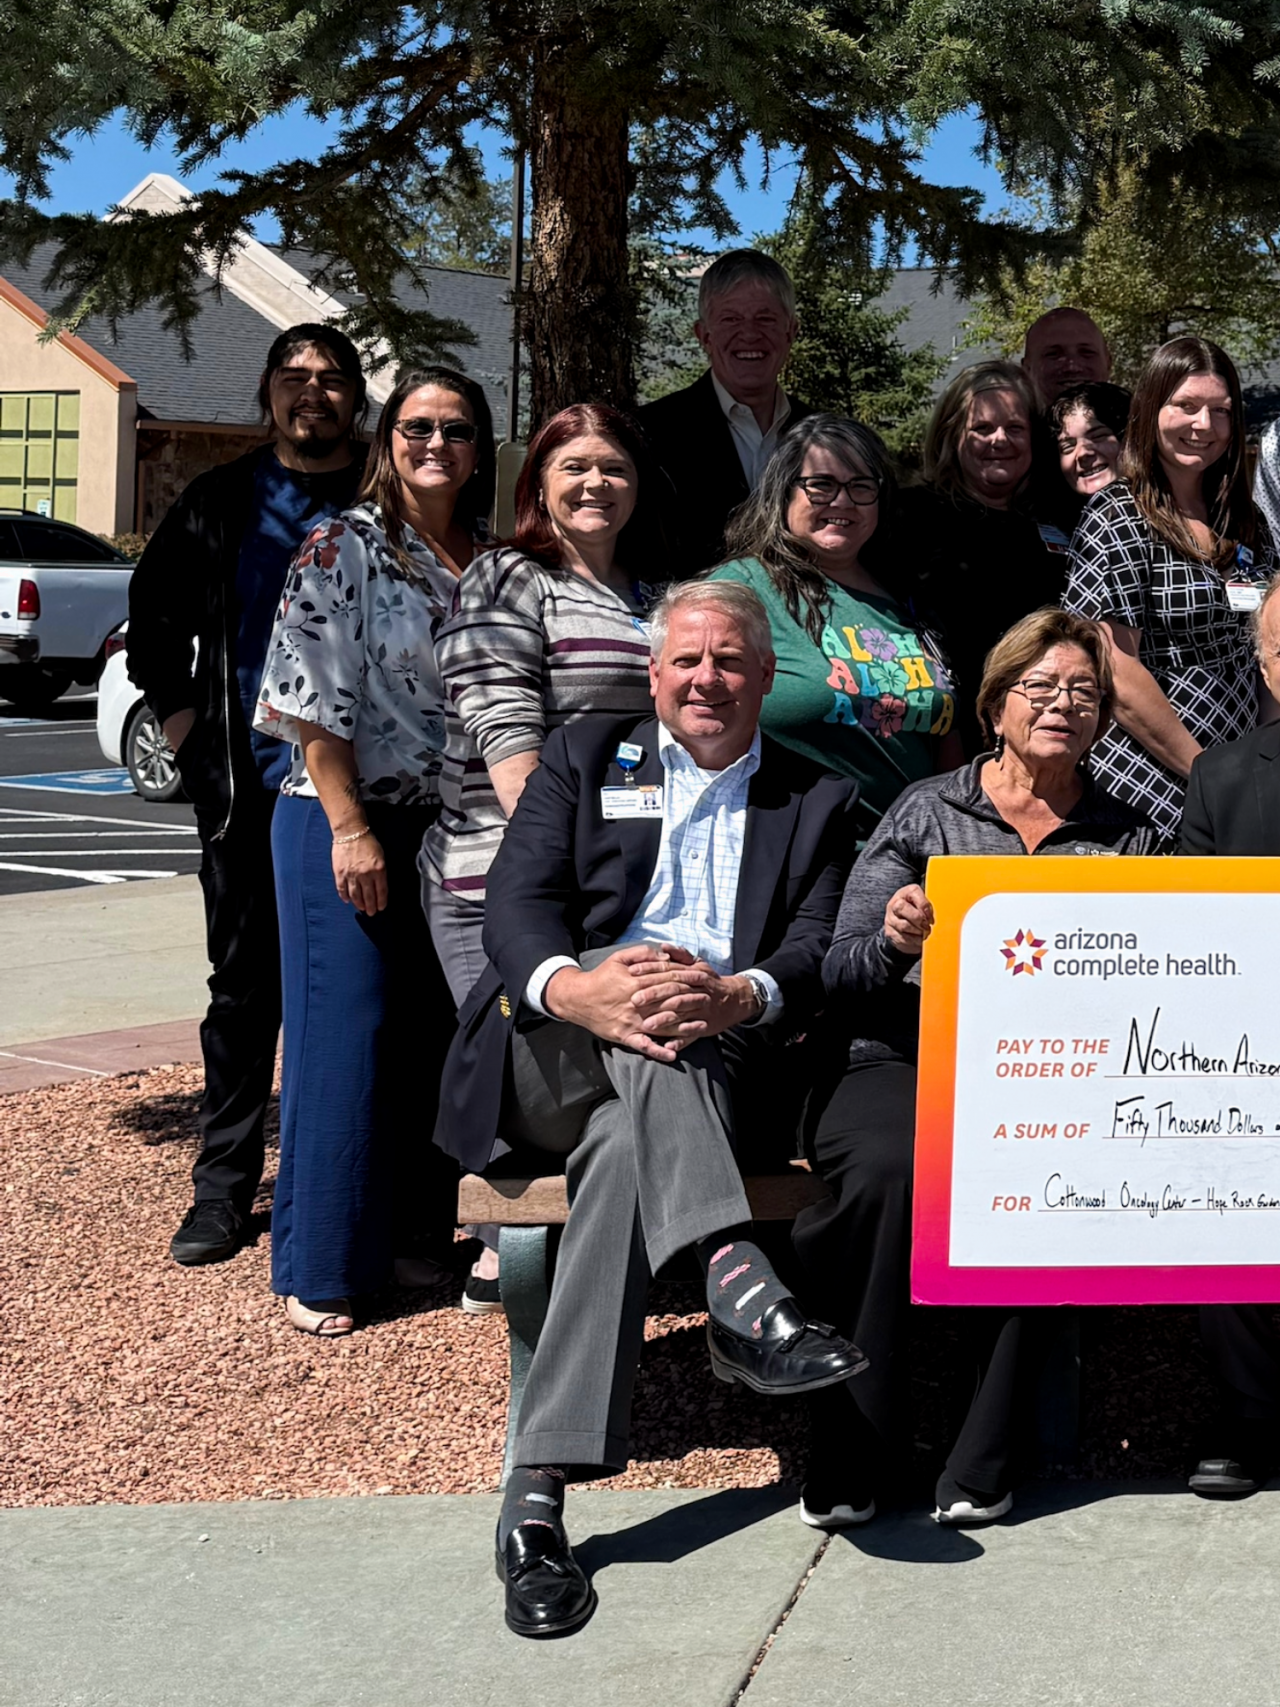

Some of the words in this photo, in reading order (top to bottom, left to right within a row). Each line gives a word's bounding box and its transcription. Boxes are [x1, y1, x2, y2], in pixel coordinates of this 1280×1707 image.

[1054, 928, 1138, 951] arizona
[1053, 953, 1160, 980] complete
[996, 1039, 1032, 1055] PAY
[1039, 1039, 1065, 1055] TO
[1072, 1039, 1111, 1055] THE
[1123, 1007, 1228, 1075] Northern
[996, 1062, 1065, 1078] ORDER
[1071, 1062, 1098, 1078] OF
[993, 1124, 1008, 1139] A
[1014, 1124, 1057, 1139] SUM
[1063, 1124, 1091, 1139] OF
[1112, 1096, 1150, 1148] Fifty
[1155, 1101, 1222, 1138] Thousand
[1227, 1107, 1264, 1135] Dollars
[991, 1196, 1032, 1212] FOR
[1044, 1172, 1106, 1208] Cottonwood
[1120, 1181, 1159, 1218] Oncology
